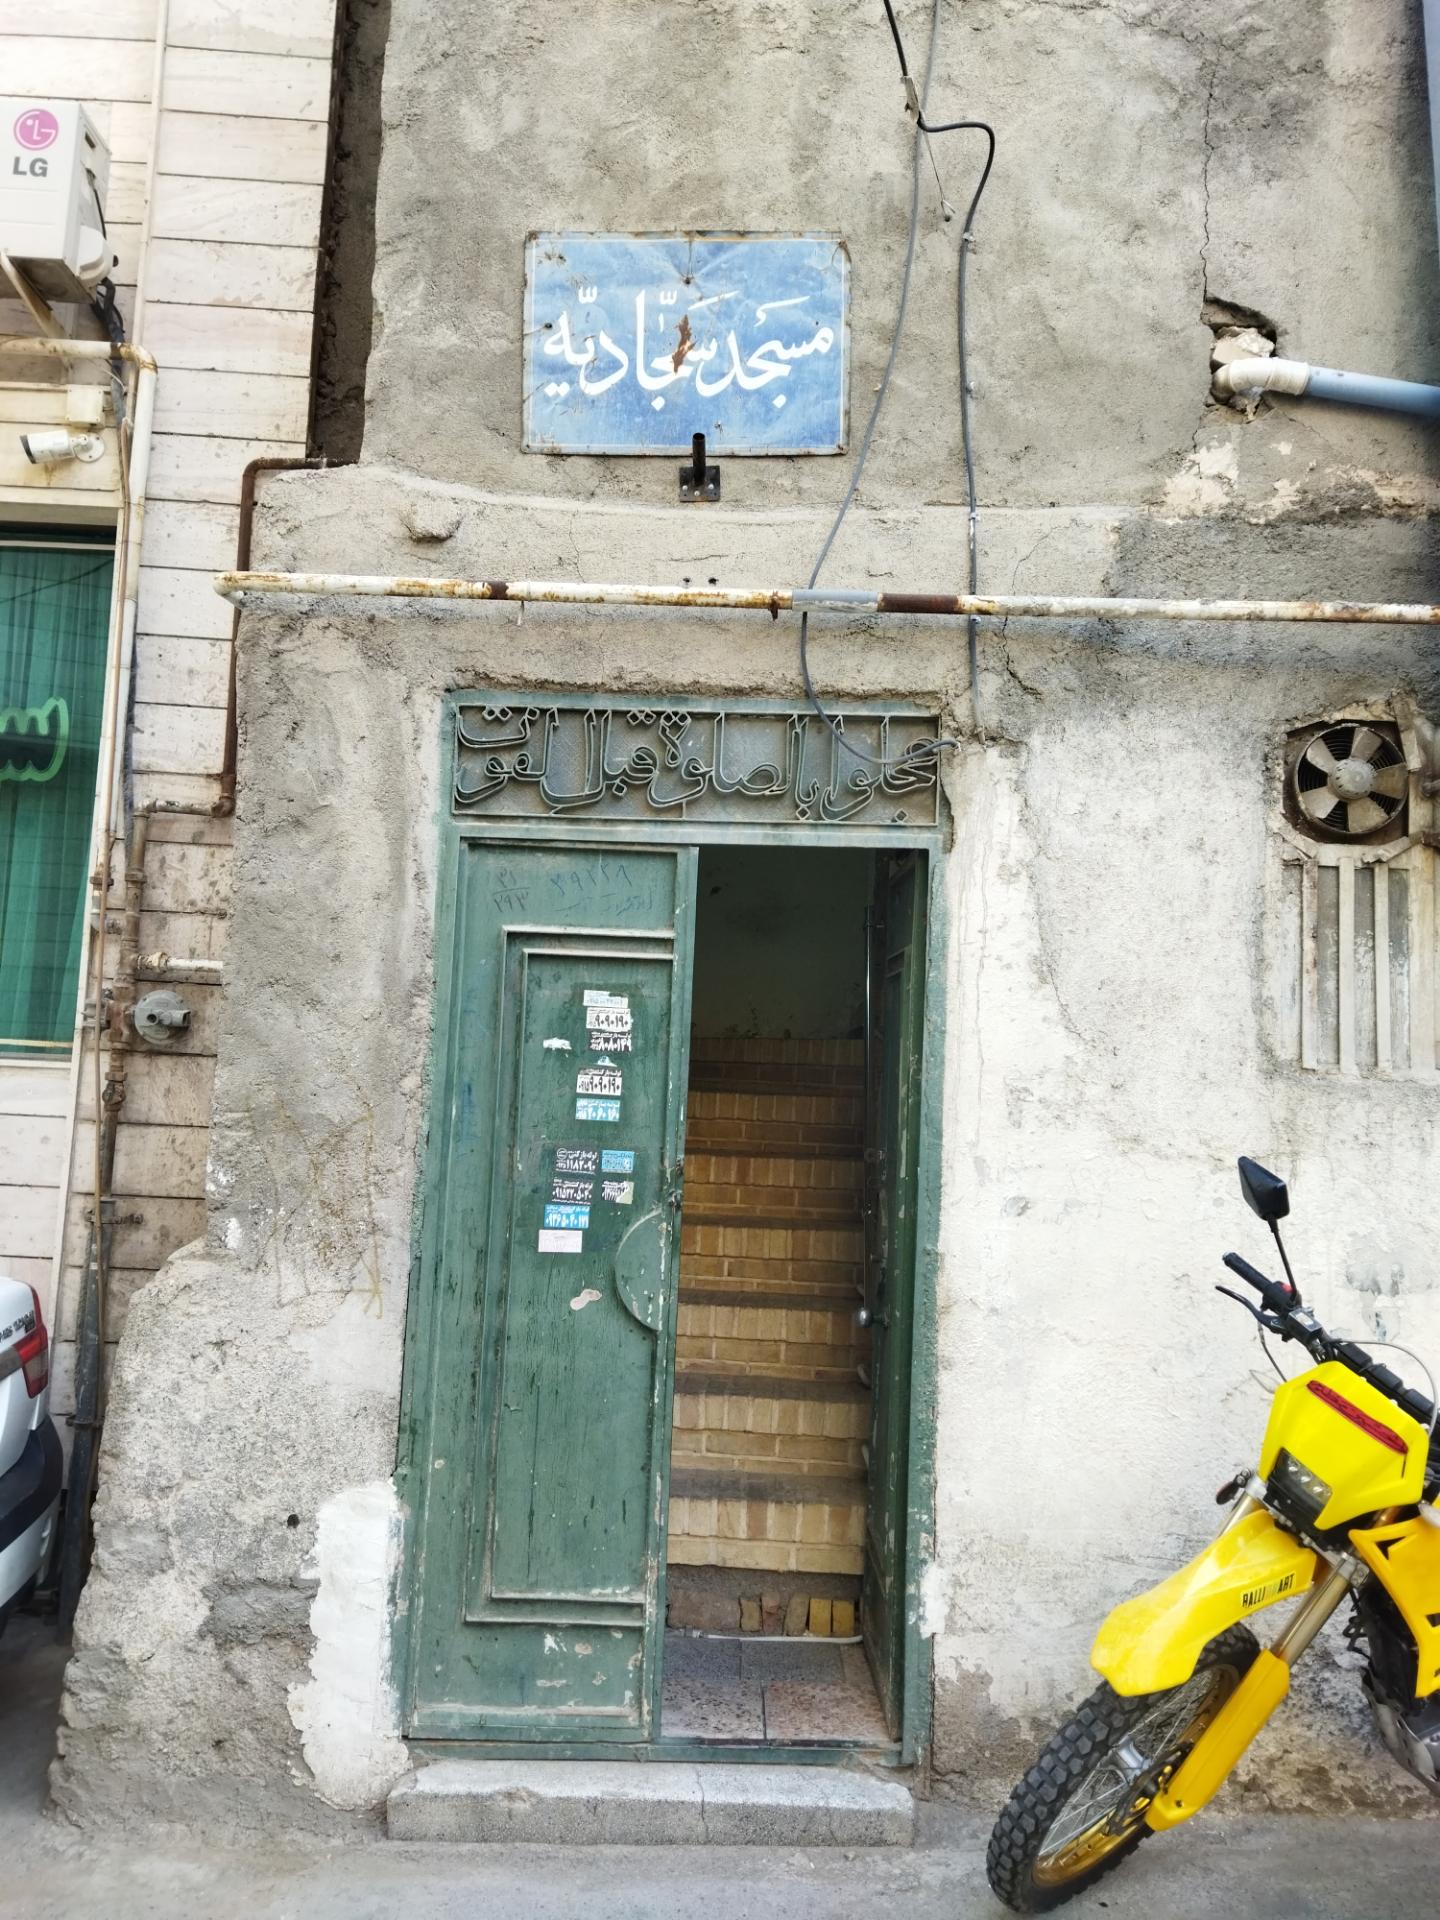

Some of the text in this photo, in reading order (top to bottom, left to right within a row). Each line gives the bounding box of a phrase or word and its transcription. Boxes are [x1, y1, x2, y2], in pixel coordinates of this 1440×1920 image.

[12, 156, 48, 178] LG
[1242, 1573, 1295, 1608] RALLI ART
